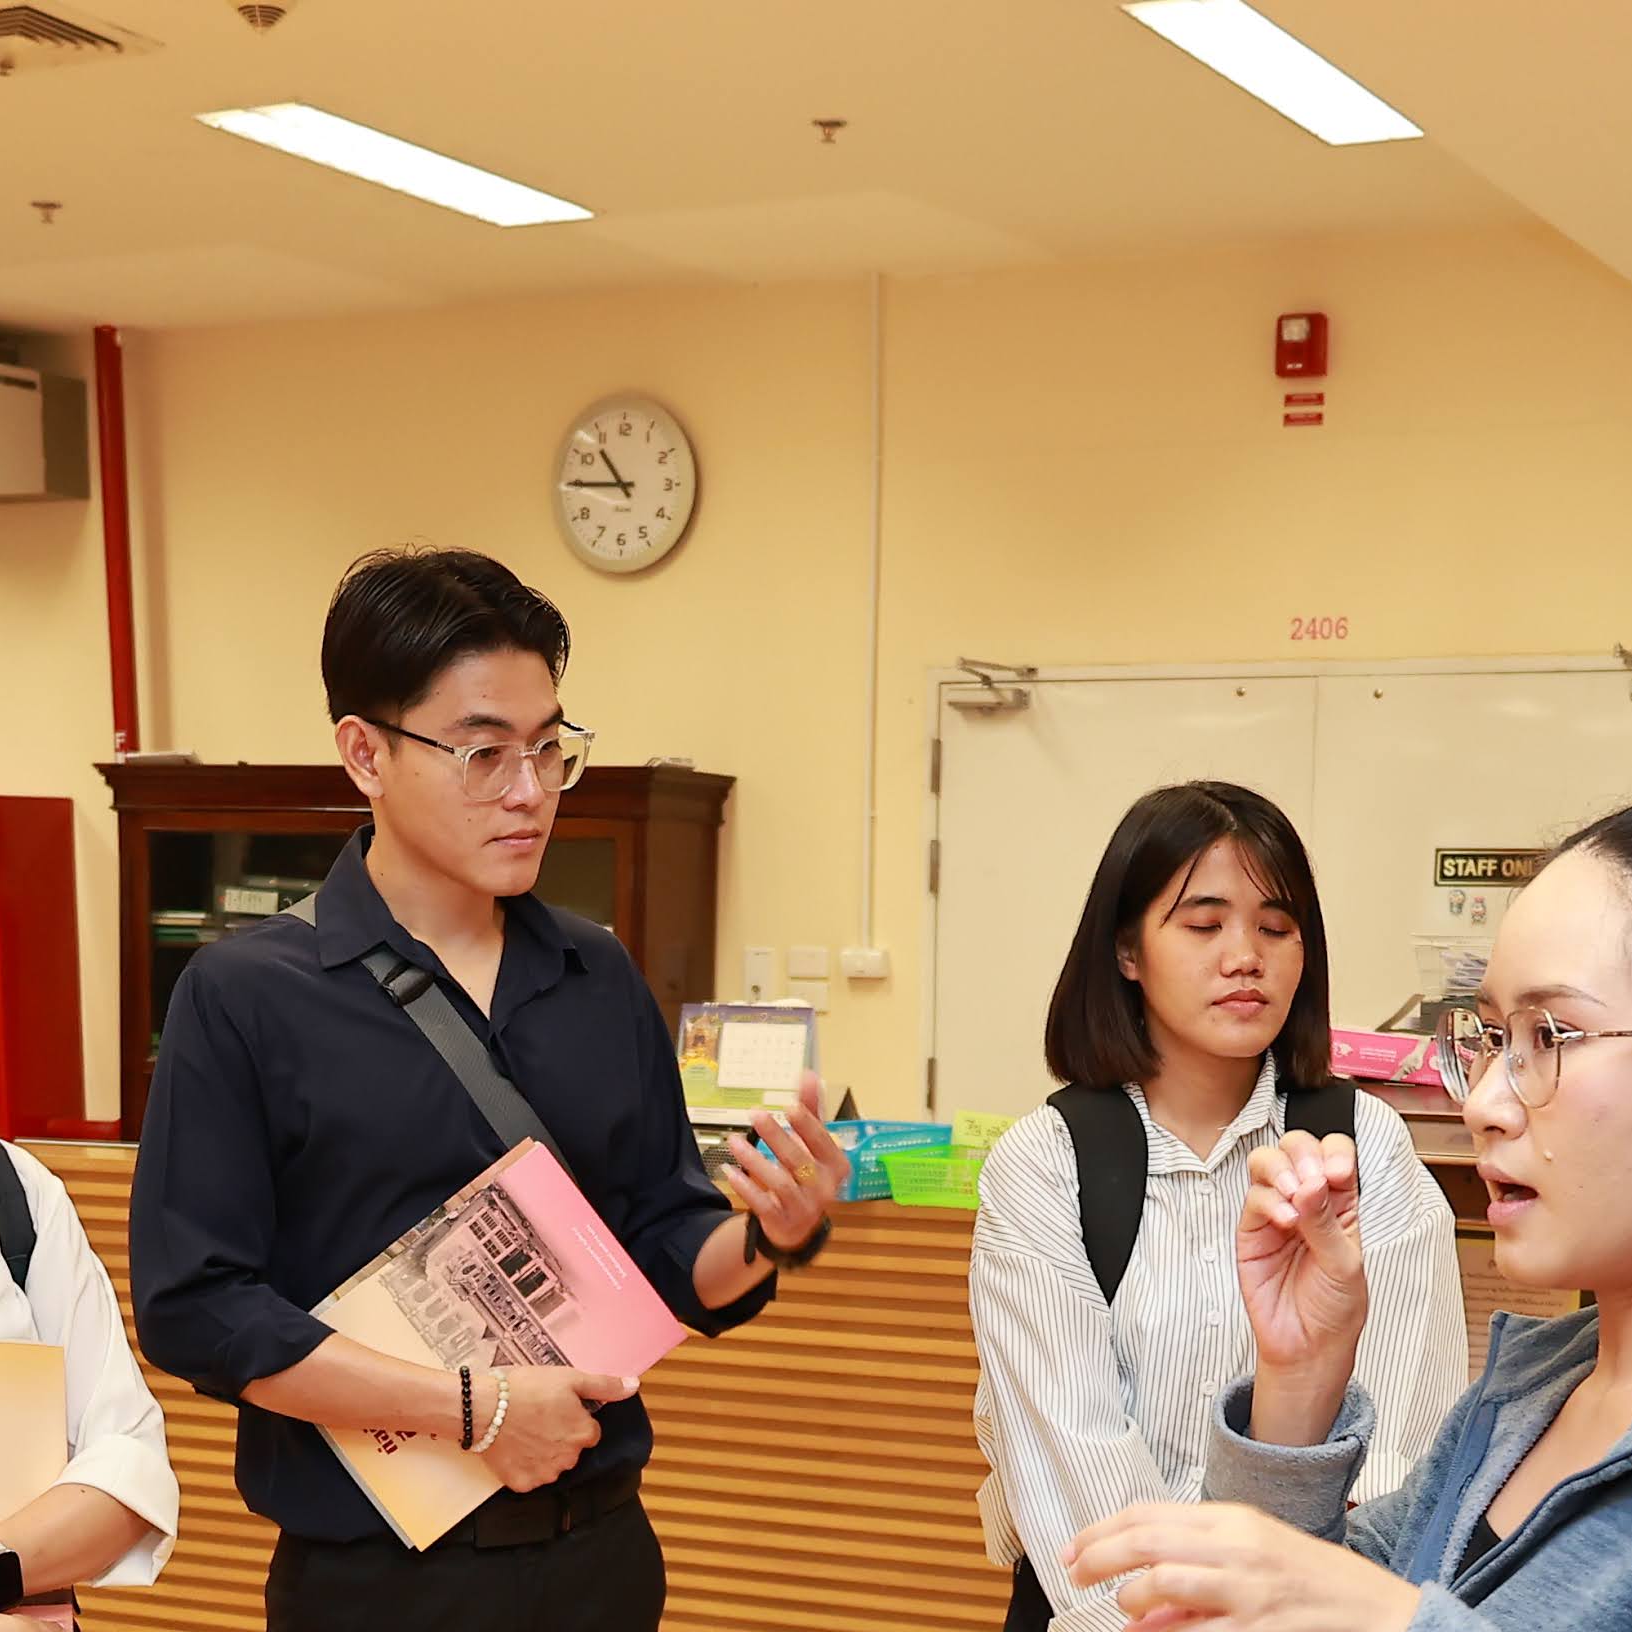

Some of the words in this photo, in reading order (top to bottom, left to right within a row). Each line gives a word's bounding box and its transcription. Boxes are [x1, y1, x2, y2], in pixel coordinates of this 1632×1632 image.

[618, 422, 633, 437] 12
[598, 431, 608, 444] 11
[580, 452, 595, 466] 10
[657, 451, 668, 465] 2
[663, 478, 674, 492] 3
[579, 506, 591, 521] 8
[655, 506, 666, 520] 4
[596, 525, 607, 539] 7
[638, 525, 648, 539] 5
[616, 533, 627, 547] 6
[1290, 616, 1349, 641] 2406
[1442, 858, 1498, 877] STAFF
[1501, 858, 1537, 877] ONL
